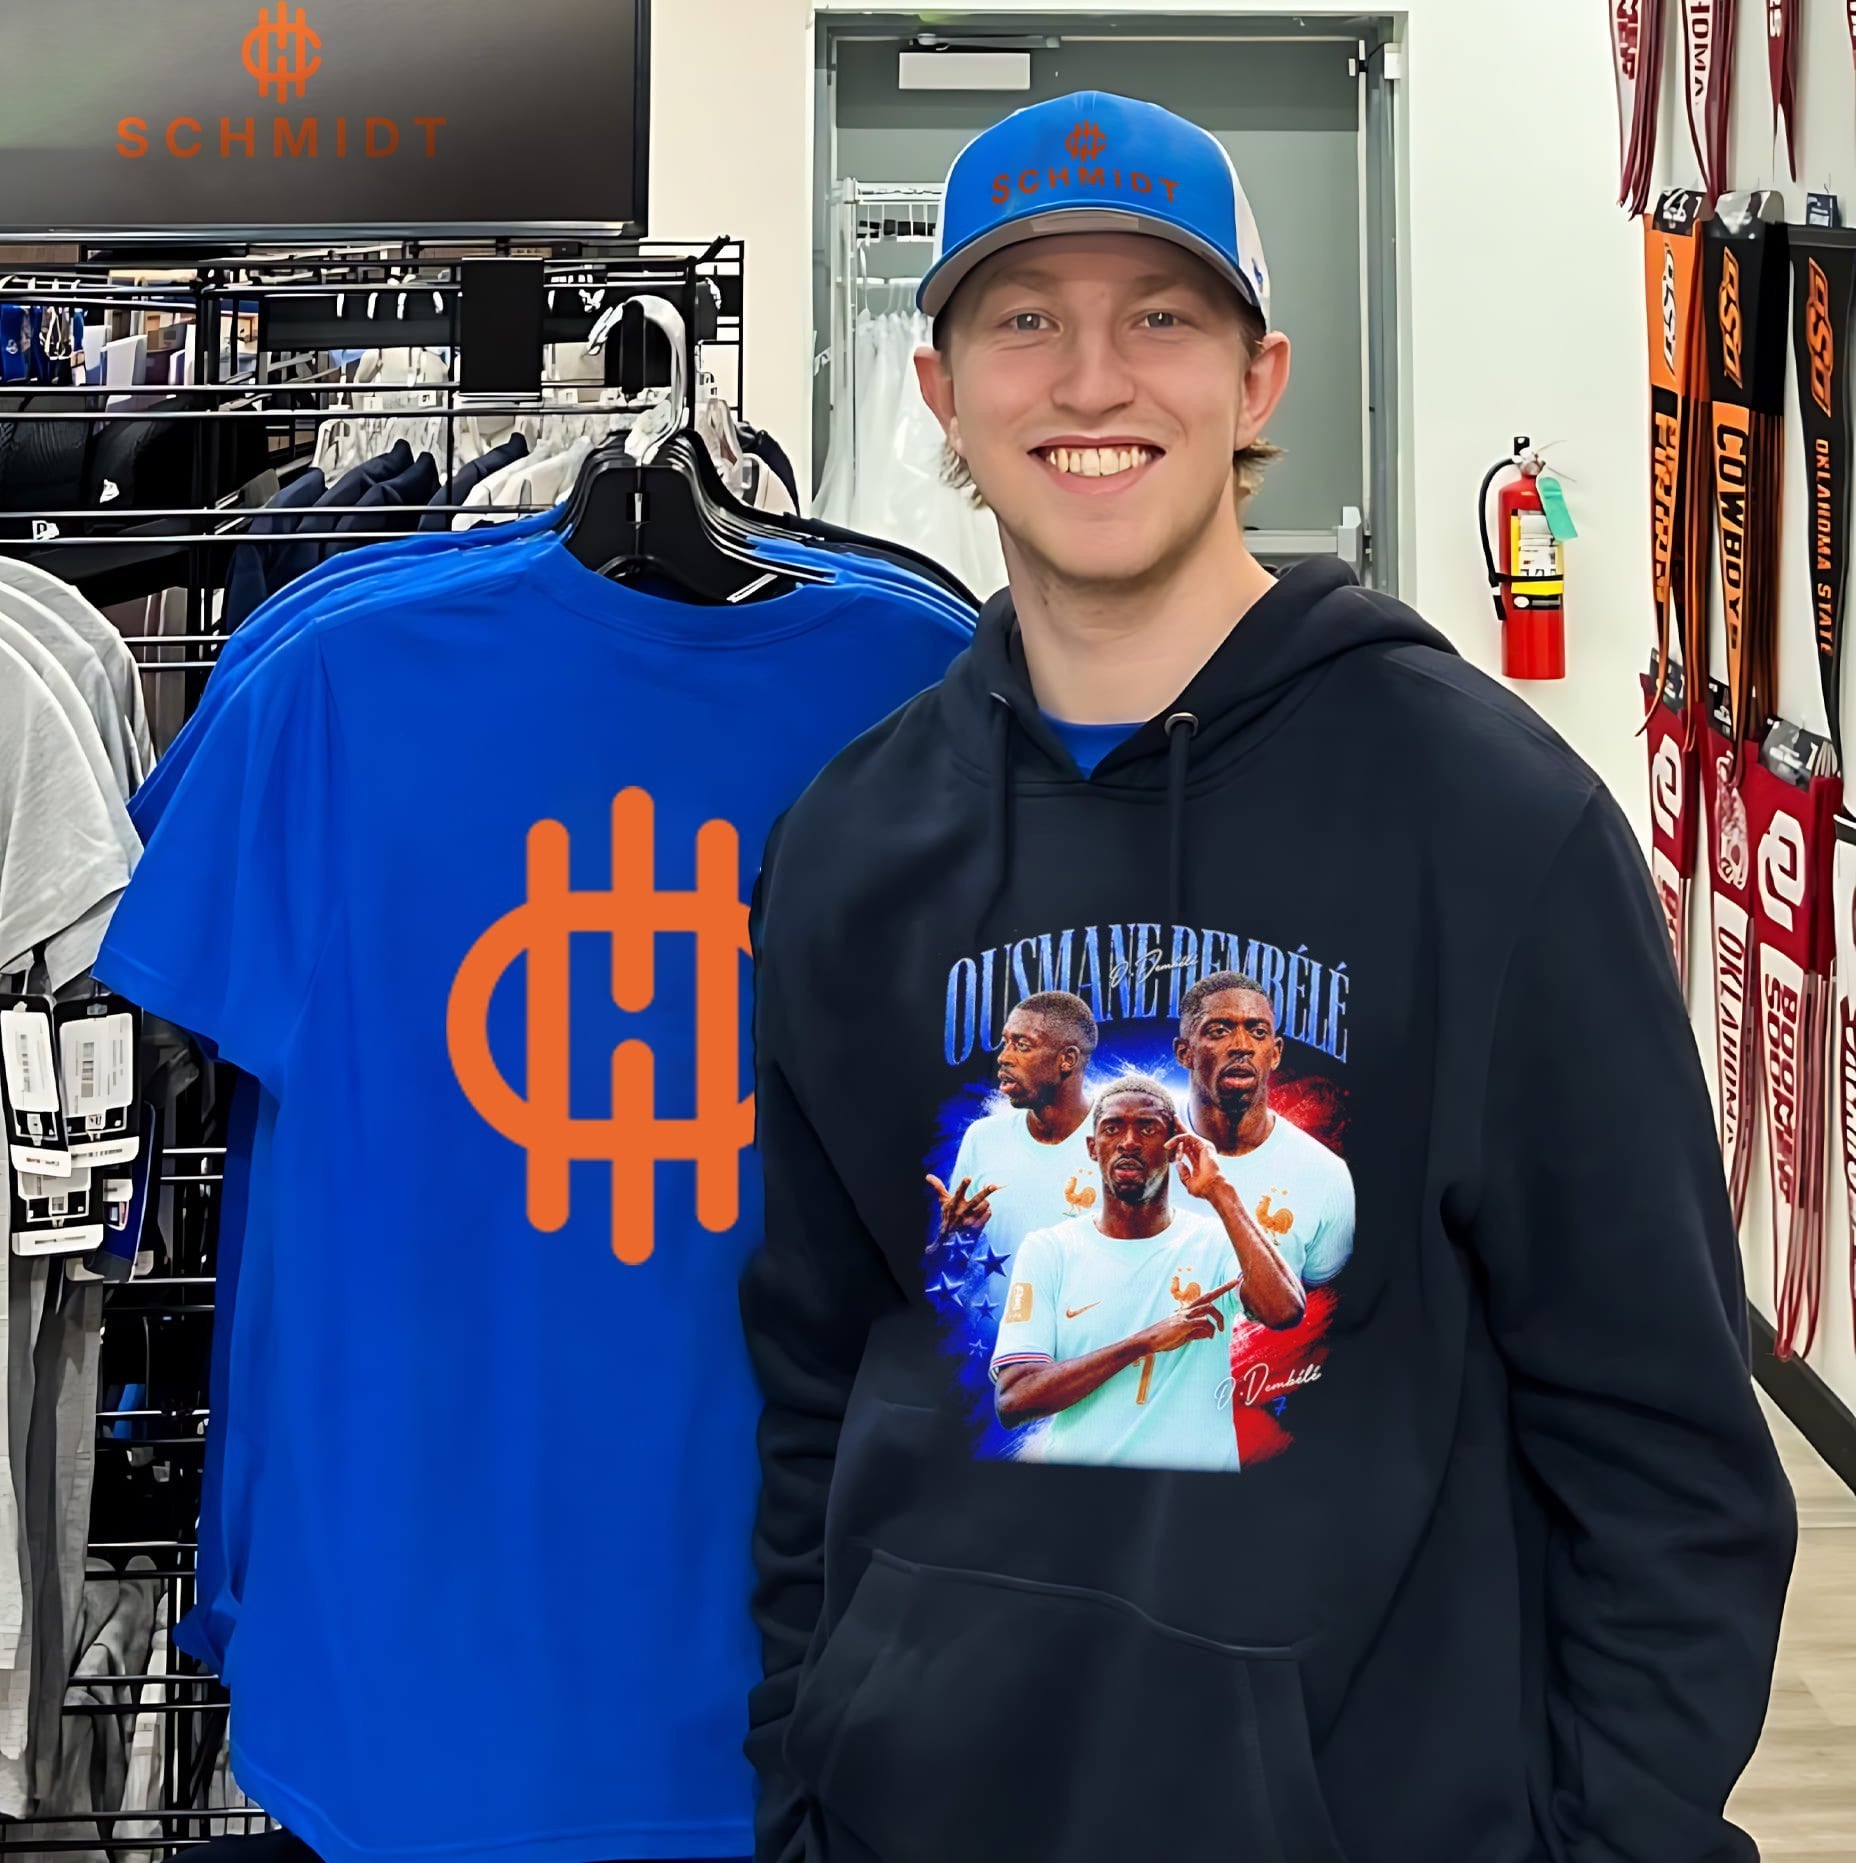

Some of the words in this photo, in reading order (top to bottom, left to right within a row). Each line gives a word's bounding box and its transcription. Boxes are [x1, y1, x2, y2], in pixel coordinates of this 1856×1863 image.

[115, 115, 448, 160] SCHMIDT
[991, 167, 1179, 204] SCHMIDT
[1815, 438, 1832, 571] OKLAHOMA
[944, 923, 1161, 1066] OUSMANE
[1717, 925, 1746, 1145] OKLAHOMA
